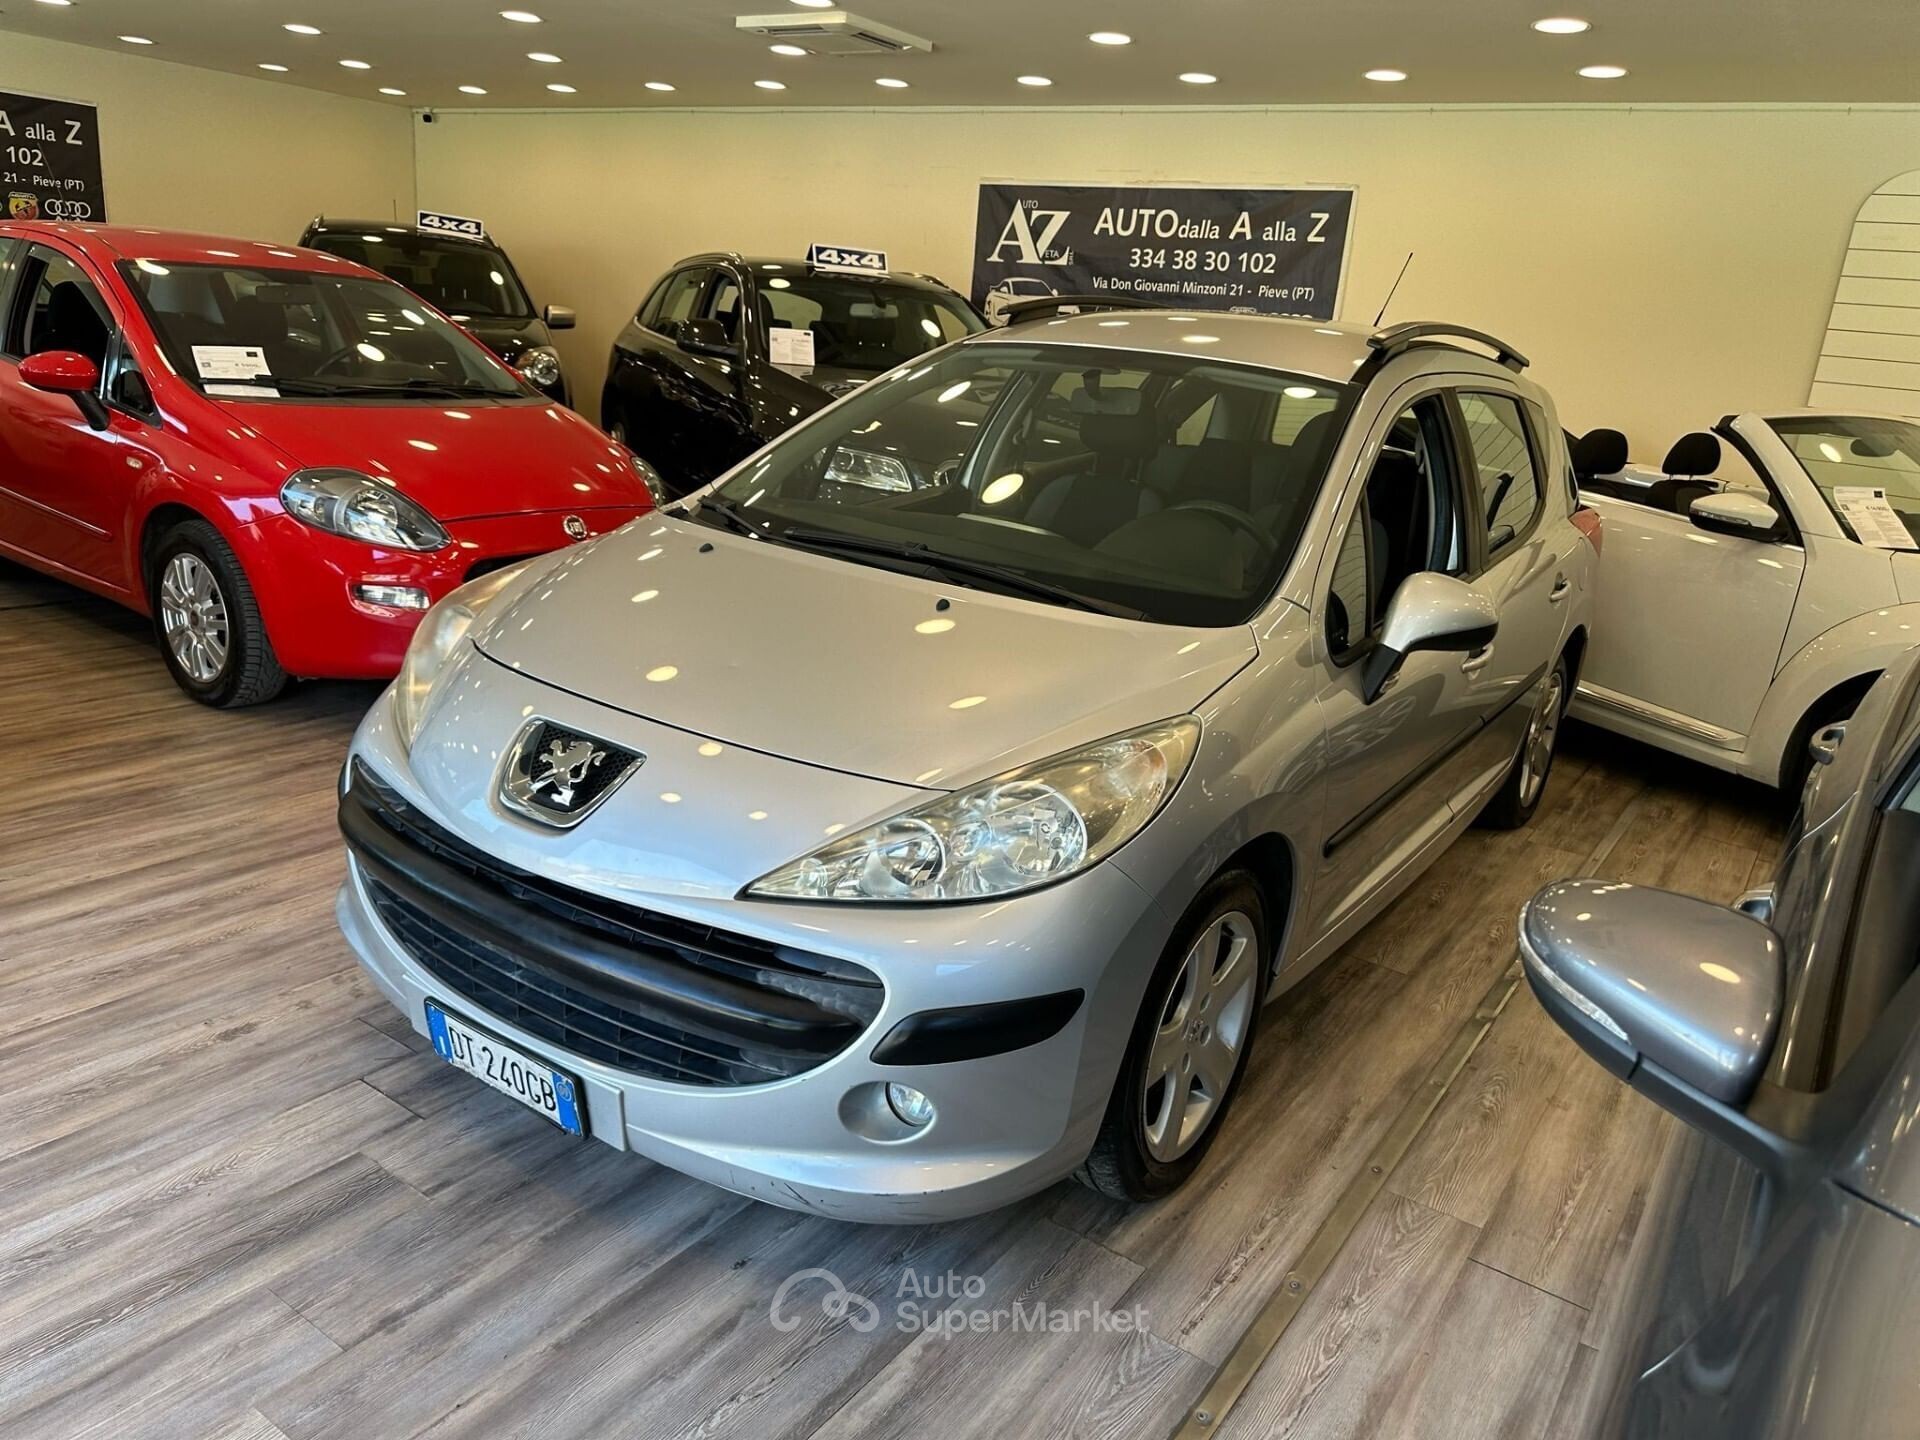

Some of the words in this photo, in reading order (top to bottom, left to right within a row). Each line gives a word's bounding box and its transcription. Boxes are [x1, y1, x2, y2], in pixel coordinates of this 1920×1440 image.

[25, 122, 56, 142] alla
[64, 119, 83, 145] Z
[6, 146, 44, 166] 102
[3, 171, 18, 183] 21
[33, 174, 61, 188] Pieve
[64, 178, 85, 192] (PT)
[421, 215, 479, 234] 4x4
[1228, 211, 1252, 240] A
[1262, 220, 1297, 242] alla
[1307, 212, 1330, 242] Z
[818, 249, 883, 269] 4x4
[1129, 247, 1166, 269] 334
[1172, 249, 1197, 270] 38
[1204, 250, 1230, 272] 30
[1238, 252, 1277, 274] 102
[1092, 276, 1108, 289] Via
[1111, 277, 1131, 290] Don
[1134, 279, 1180, 293] Giovanni
[1182, 281, 1227, 295] Minzoni
[1229, 284, 1244, 296] 21
[1258, 285, 1288, 298] Pieve
[1292, 286, 1315, 302] (PT)
[449, 1026, 475, 1067] DT
